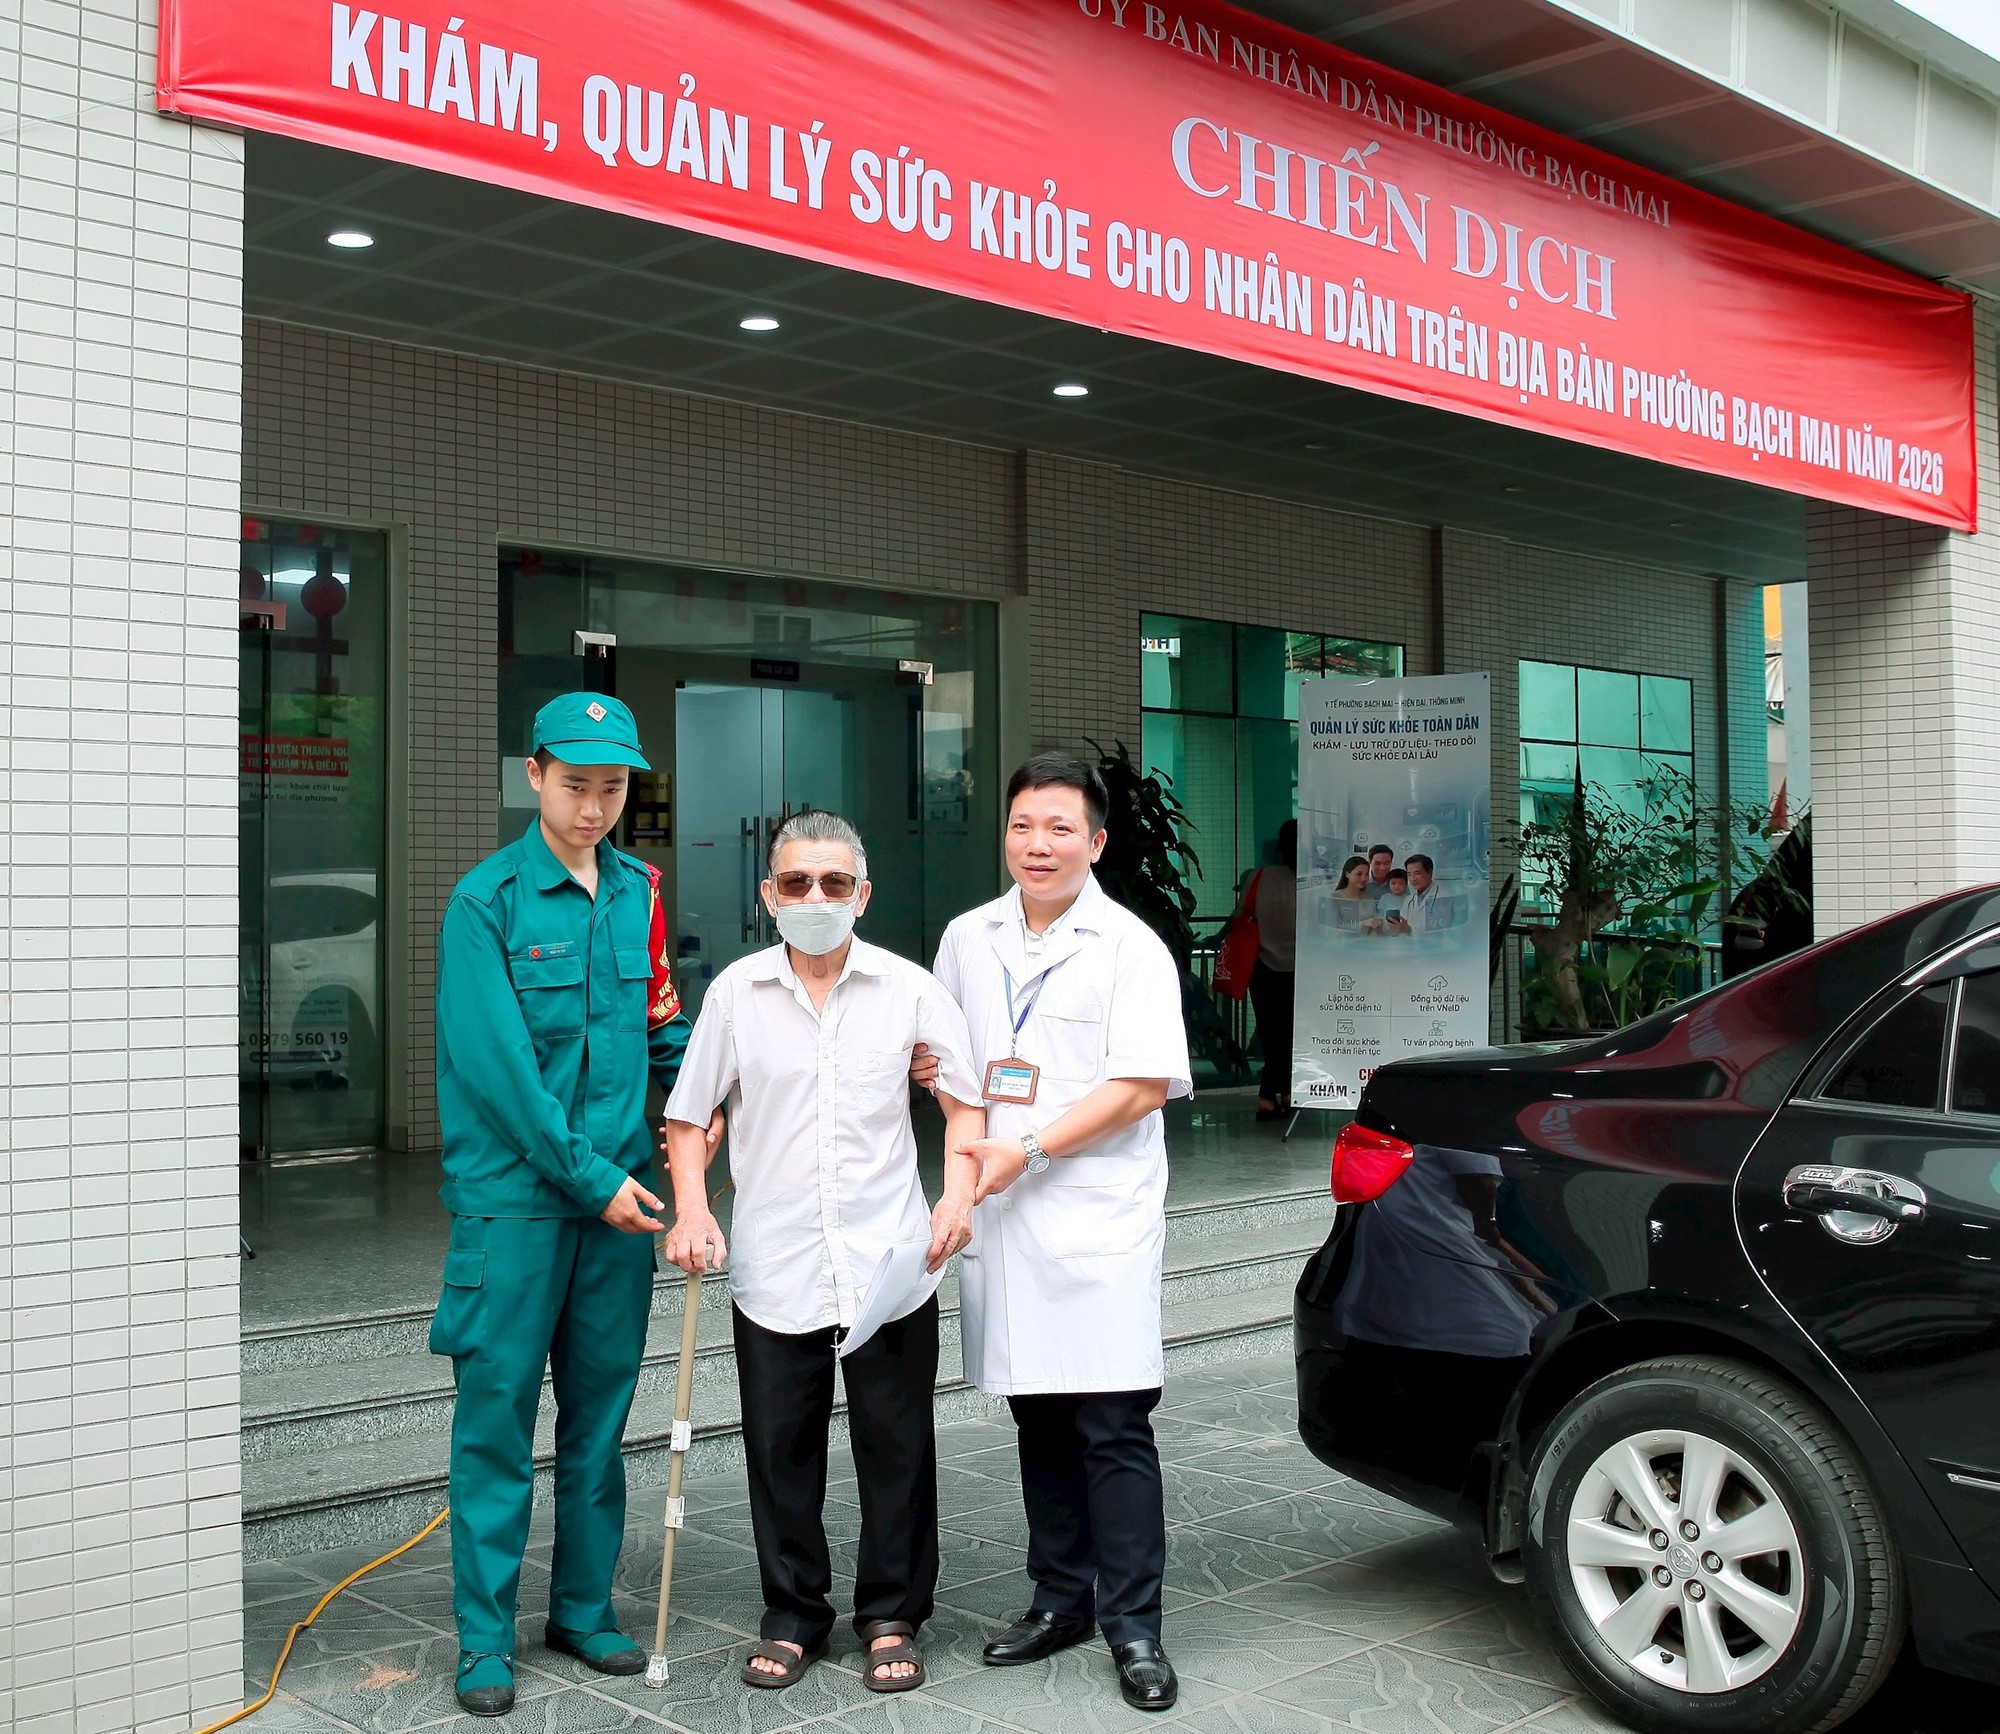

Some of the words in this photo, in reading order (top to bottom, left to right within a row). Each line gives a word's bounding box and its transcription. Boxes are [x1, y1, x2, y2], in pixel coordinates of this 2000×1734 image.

[1143, 2, 1220, 63] BAN
[1230, 35, 1330, 104] NHÂN
[1339, 76, 1405, 131] DÂN
[1414, 106, 1537, 179] PHƯỜNG
[1543, 156, 1618, 210] BẠCH
[1624, 184, 1672, 227] MAI
[1170, 116, 1430, 265] CHIẾN
[1452, 203, 1619, 320] DỊCH
[330, 2, 559, 152] KHÁM,
[582, 72, 749, 191] QUẢN
[769, 120, 832, 209] LÝ
[849, 145, 953, 242] SỨC
[970, 179, 1091, 280] KHỎE
[1105, 221, 1191, 303] CHO
[1205, 251, 1313, 337] NHÂN
[1323, 277, 1397, 358] DÂN
[1406, 304, 1489, 382] TRÊN
[1497, 330, 1549, 405] ĐỊA
[1557, 342, 1614, 413] BÀN
[1622, 369, 1725, 442] PHƯỜNG
[1732, 397, 1793, 461] BẠCH
[1800, 415, 1840, 470] MAI
[1847, 423, 1893, 484] NĂM
[1898, 443, 1944, 496] 2026
[1382, 700, 1393, 708] MAI
[1450, 696, 1466, 705] MINH
[1310, 716, 1342, 736] QUẢN
[1345, 718, 1359, 734] LÝ
[1362, 717, 1386, 734] SỨC
[1389, 715, 1419, 734] KHỎE
[1423, 716, 1453, 733] TOÀN
[1456, 713, 1479, 730] DÂN
[1313, 739, 1341, 750] KHÁM
[1434, 738, 1459, 747] THEO
[1352, 751, 1371, 760] SỨC
[1374, 750, 1399, 760] KHỎE
[1402, 750, 1418, 760] DÀI
[1420, 749, 1438, 759] LÂU
[295, 1032, 324, 1046] 560
[1311, 1036, 1331, 1045] Theo
[1310, 1083, 1347, 1097] KHÁM
